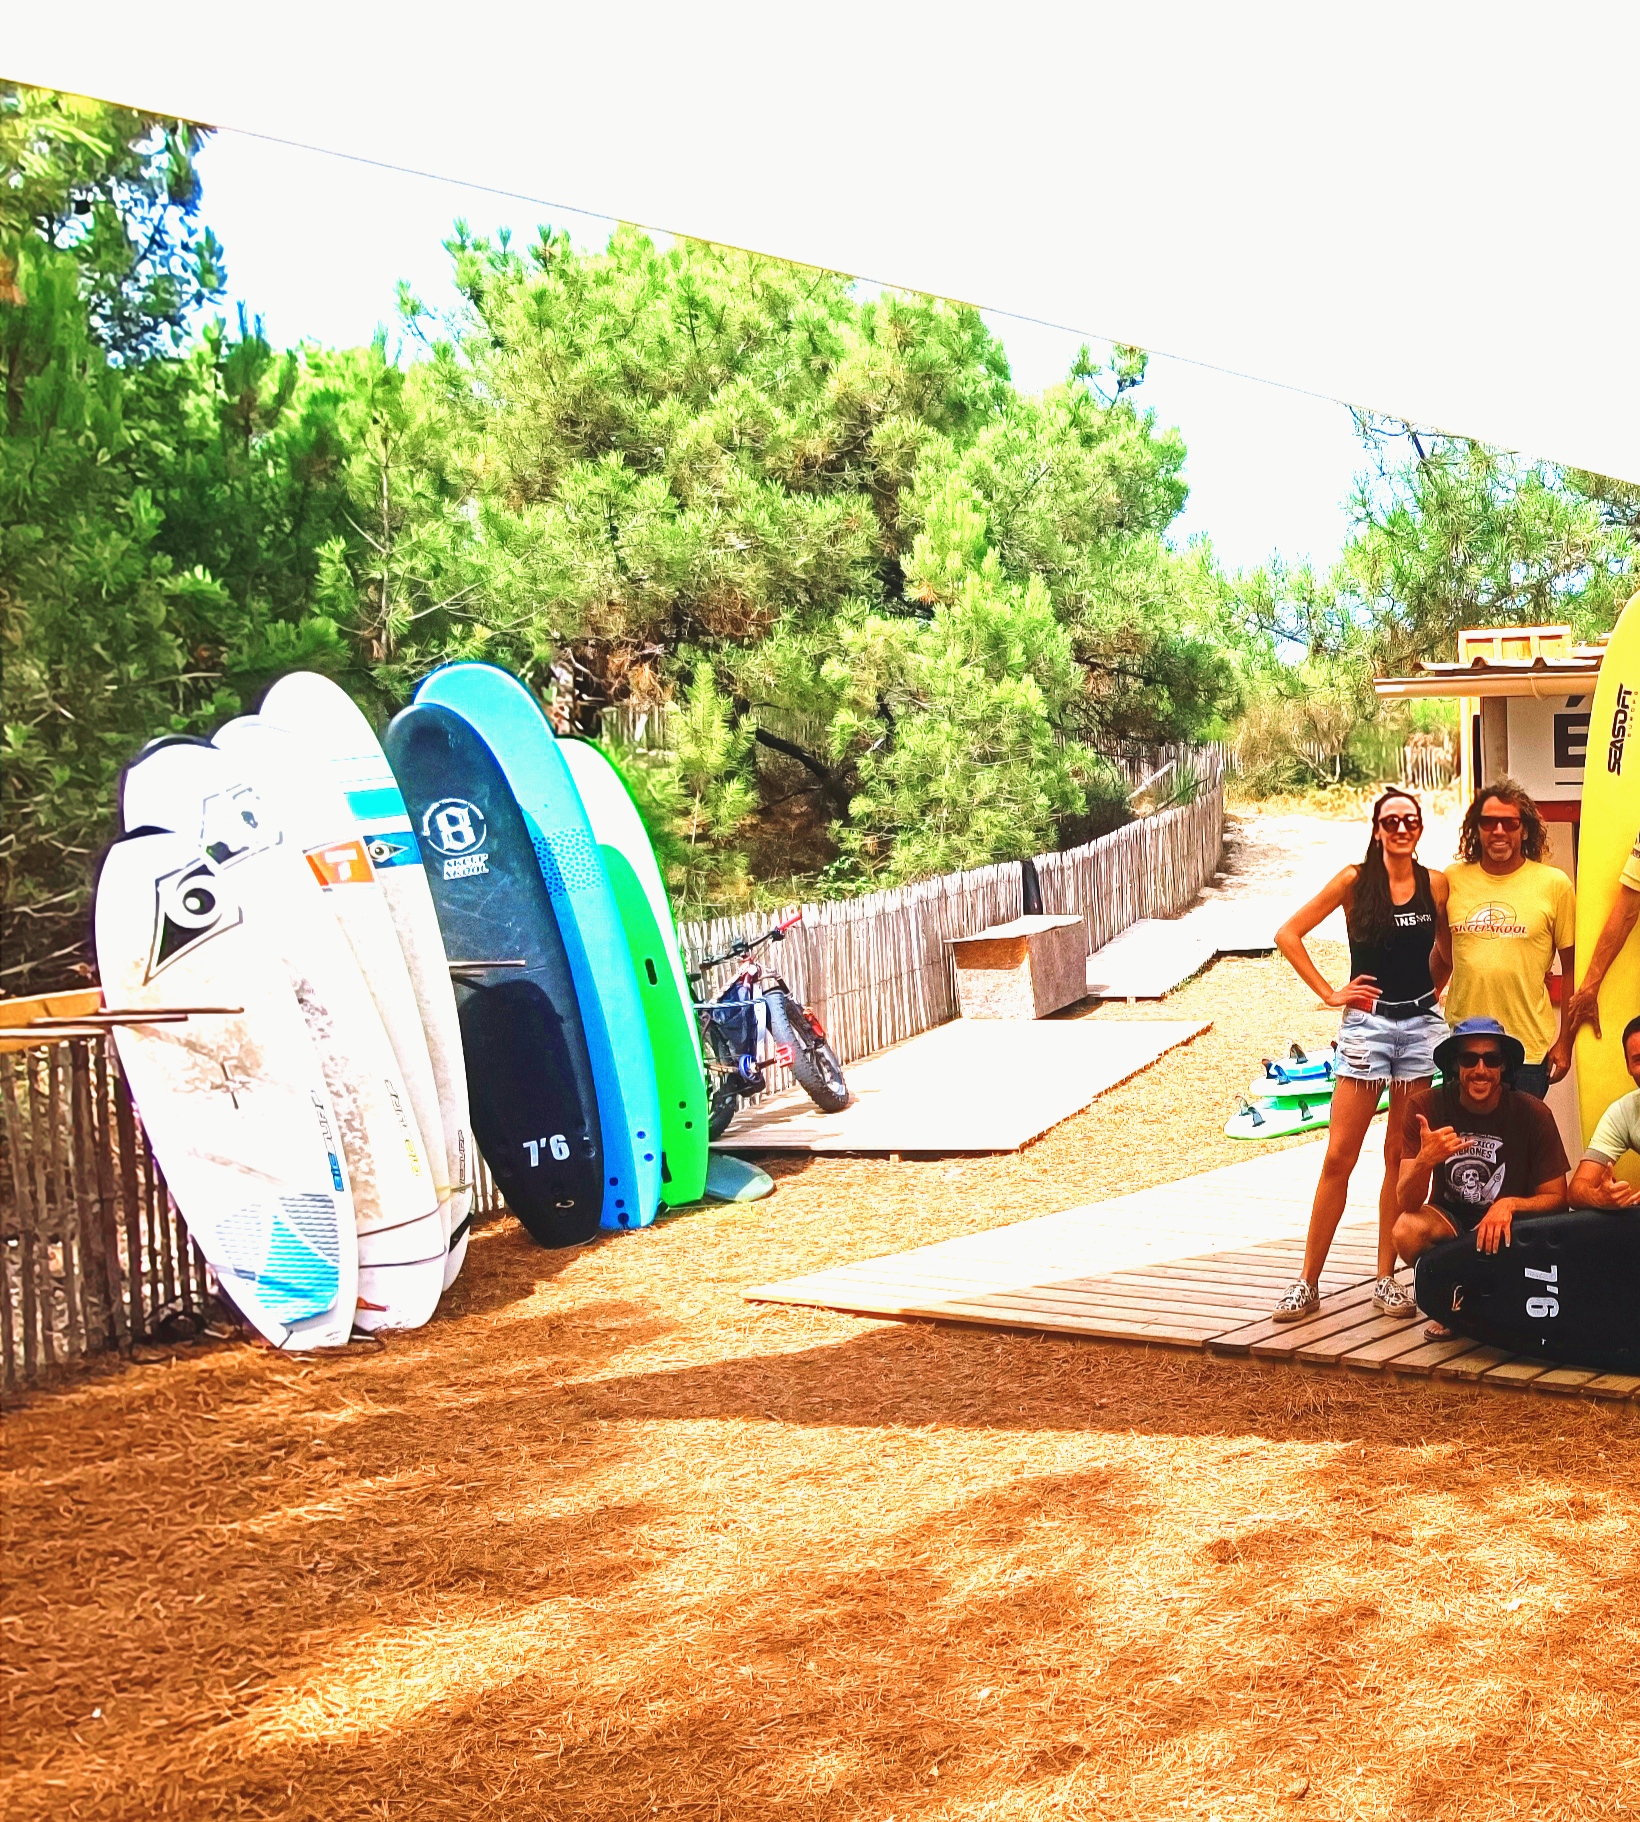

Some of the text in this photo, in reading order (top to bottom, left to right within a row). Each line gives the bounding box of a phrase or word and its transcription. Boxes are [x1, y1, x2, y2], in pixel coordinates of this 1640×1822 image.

[1607, 682, 1633, 777] SEASOFT
[522, 1133, 571, 1168] 7'6
[1524, 1264, 1560, 1318] 7'6
